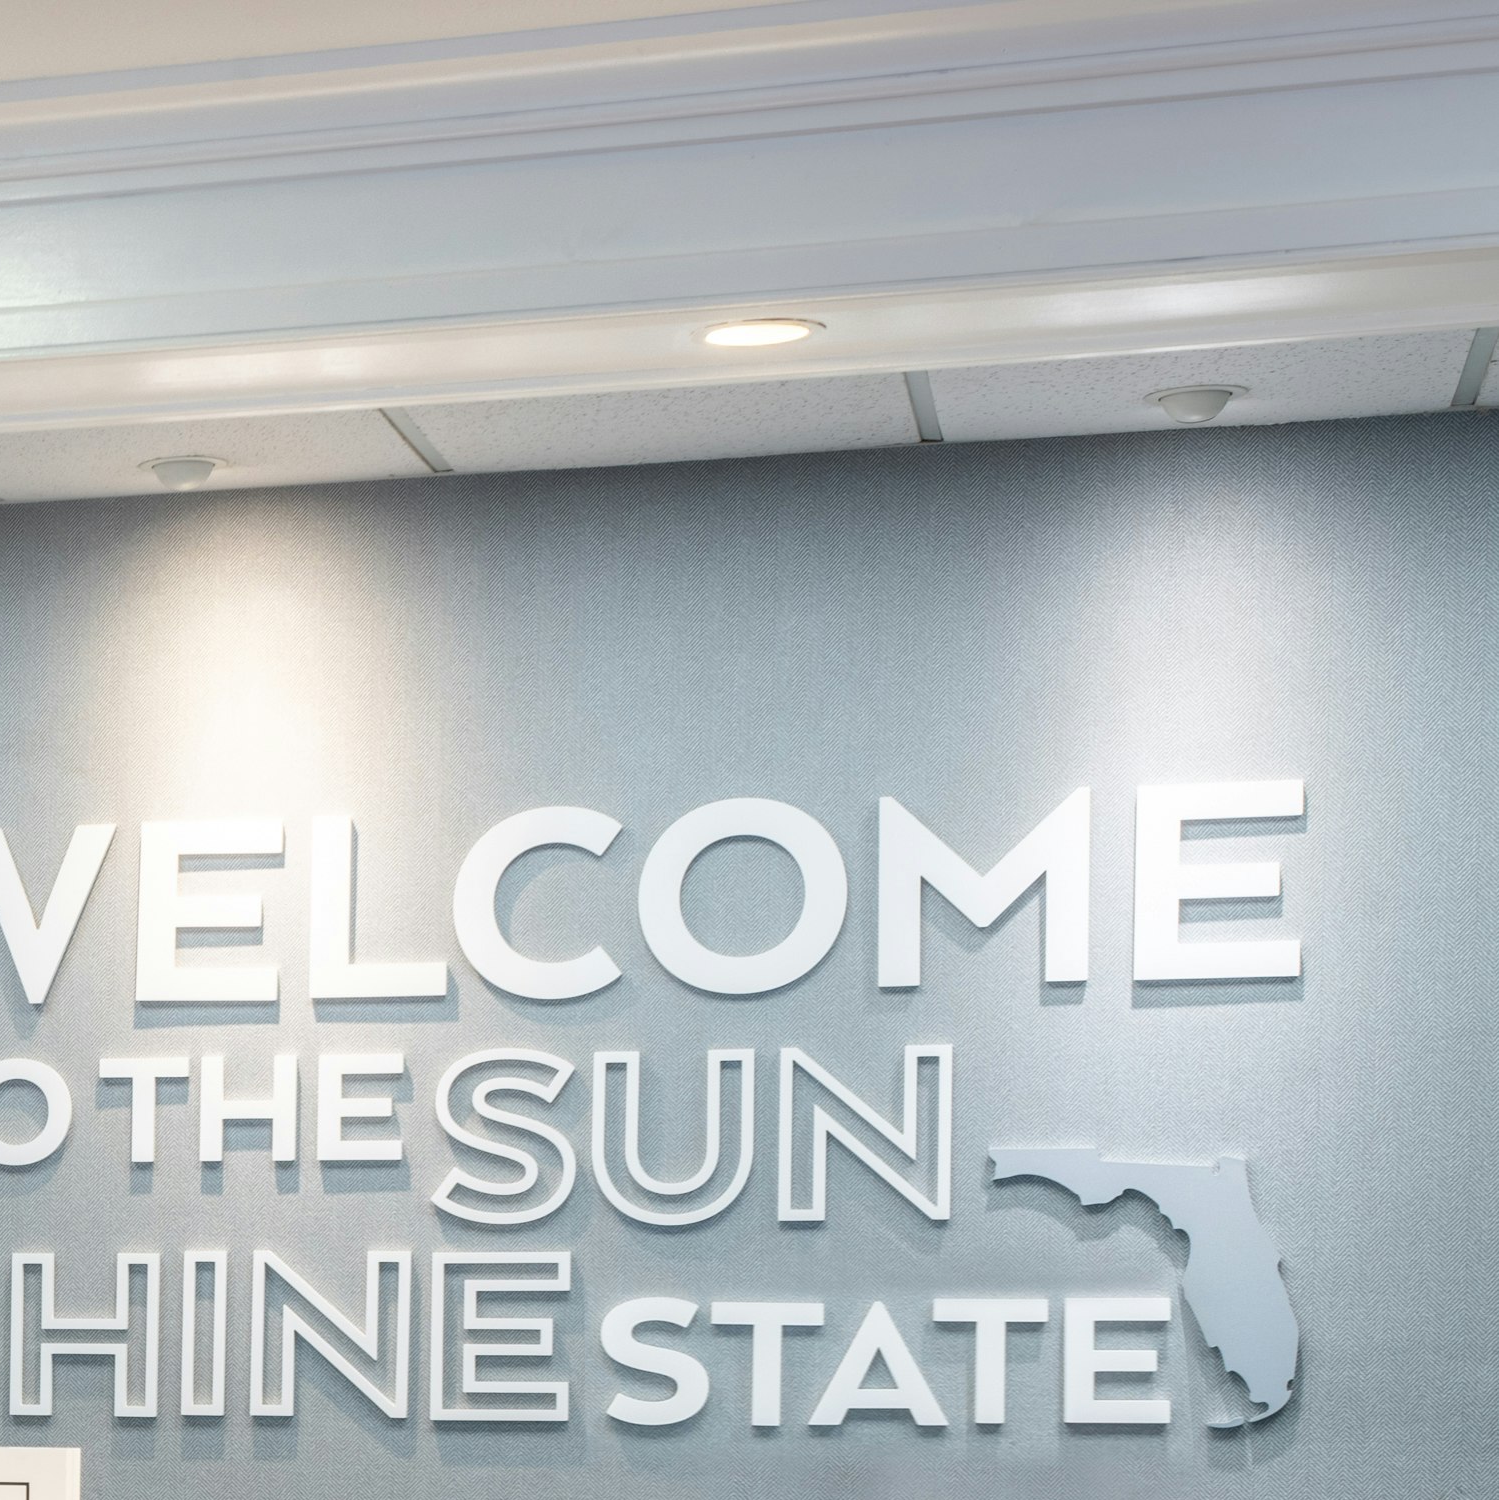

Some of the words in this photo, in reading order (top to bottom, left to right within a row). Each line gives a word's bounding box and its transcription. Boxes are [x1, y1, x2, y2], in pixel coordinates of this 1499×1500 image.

[98, 1052, 405, 1164] THE
[430, 1044, 954, 1227] SUN
[600, 1296, 1173, 1428] STATE
